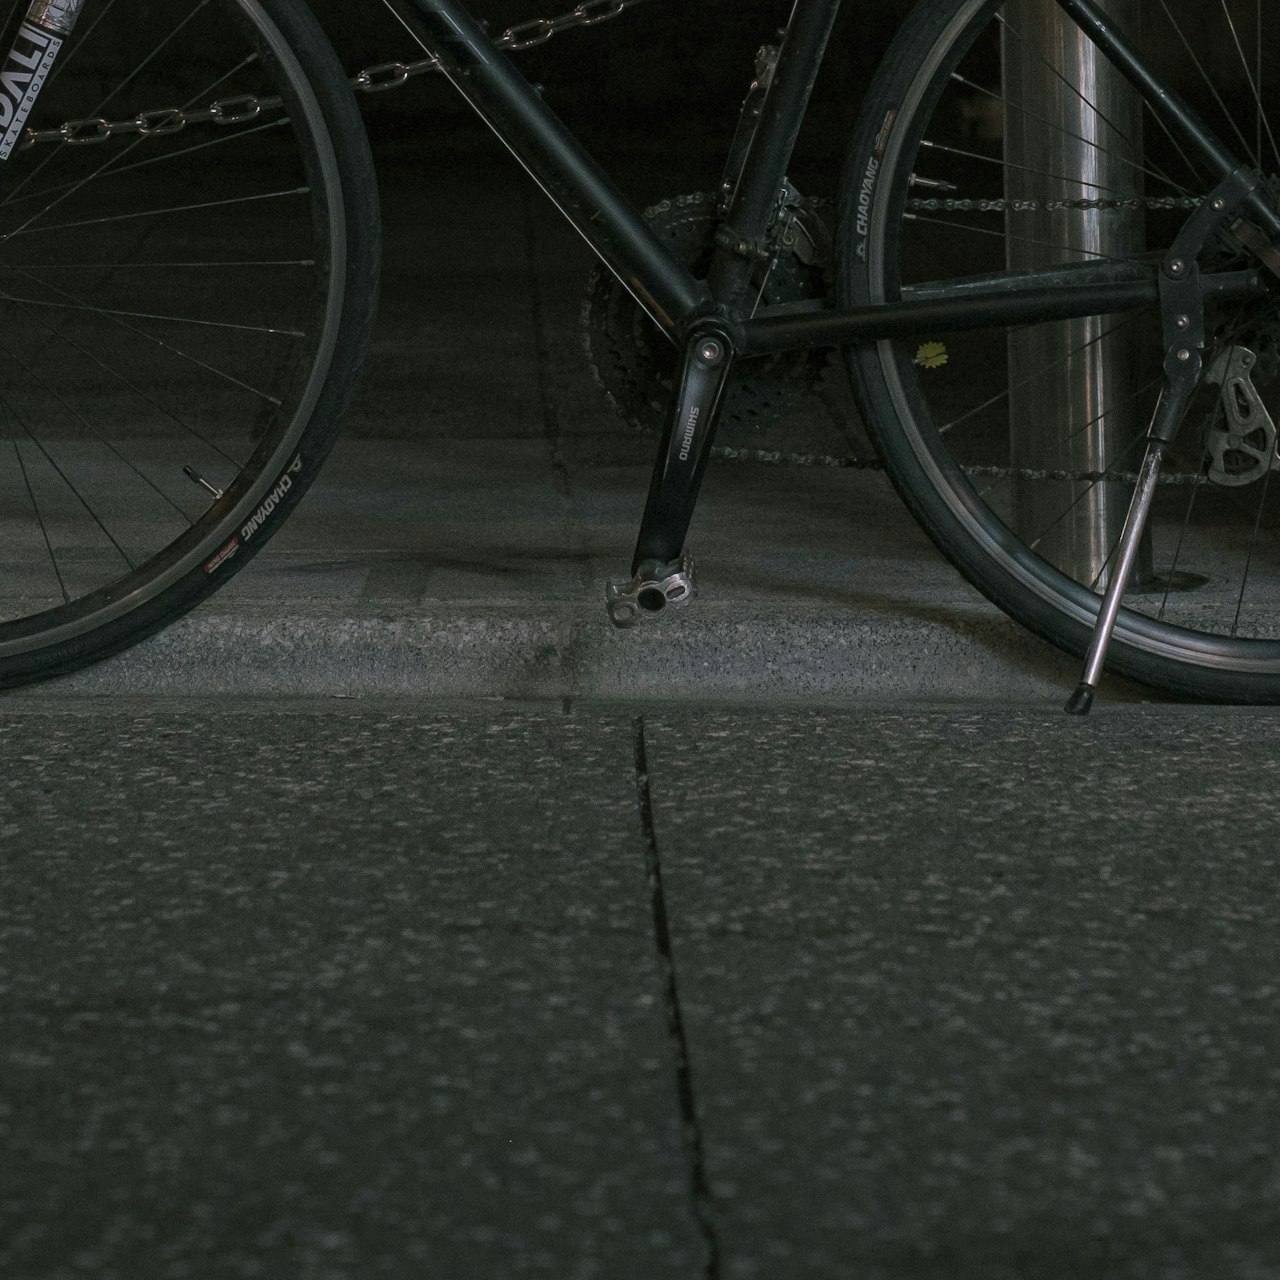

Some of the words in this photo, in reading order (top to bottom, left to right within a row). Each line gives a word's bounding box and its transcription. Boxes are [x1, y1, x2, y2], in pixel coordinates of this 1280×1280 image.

[856, 156, 879, 237] CHAOYANG
[678, 406, 700, 461] SHIMANO
[240, 474, 293, 542] CHAOYANG
